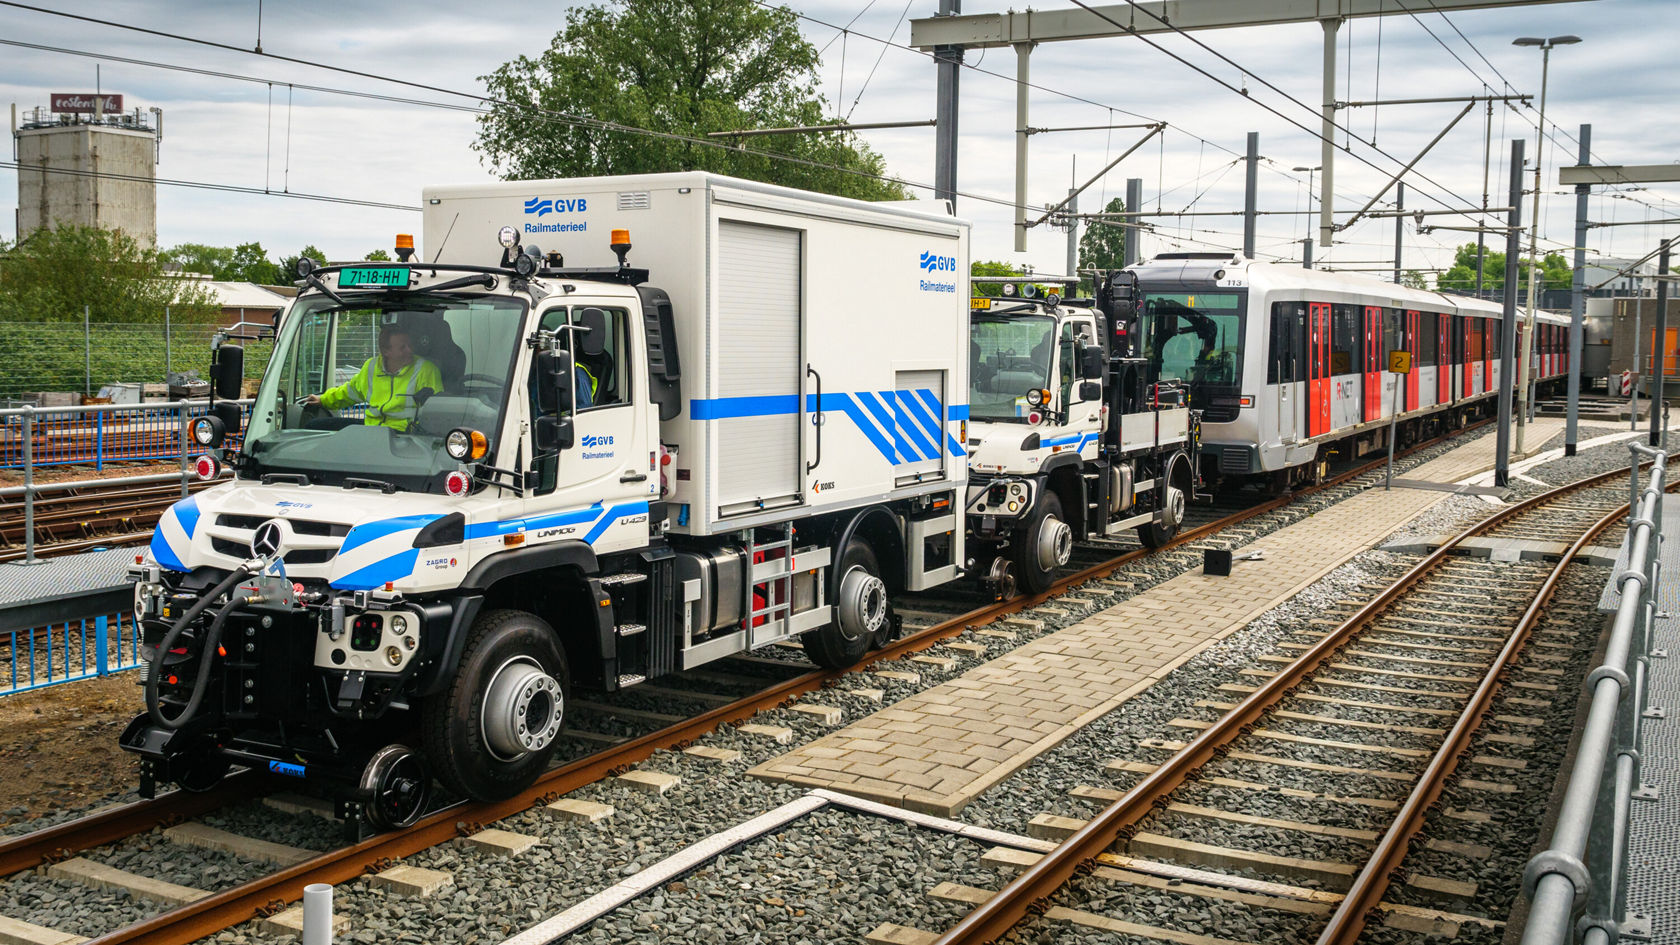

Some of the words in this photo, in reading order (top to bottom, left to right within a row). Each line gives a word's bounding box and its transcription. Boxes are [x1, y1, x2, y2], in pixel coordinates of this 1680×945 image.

[555, 199, 587, 213] GVB
[525, 221, 587, 233] Railmaterieel
[938, 256, 956, 271] GVB
[350, 271, 400, 284] 71-18-HH
[920, 280, 956, 293] Railmaterieel
[1394, 356, 1404, 368] 2
[597, 436, 614, 446] GVB
[582, 451, 614, 460] Railmaterieel
[650, 484, 655, 493] 2
[537, 527, 576, 539] UNIMOG
[426, 558, 448, 566] ZAGRO
